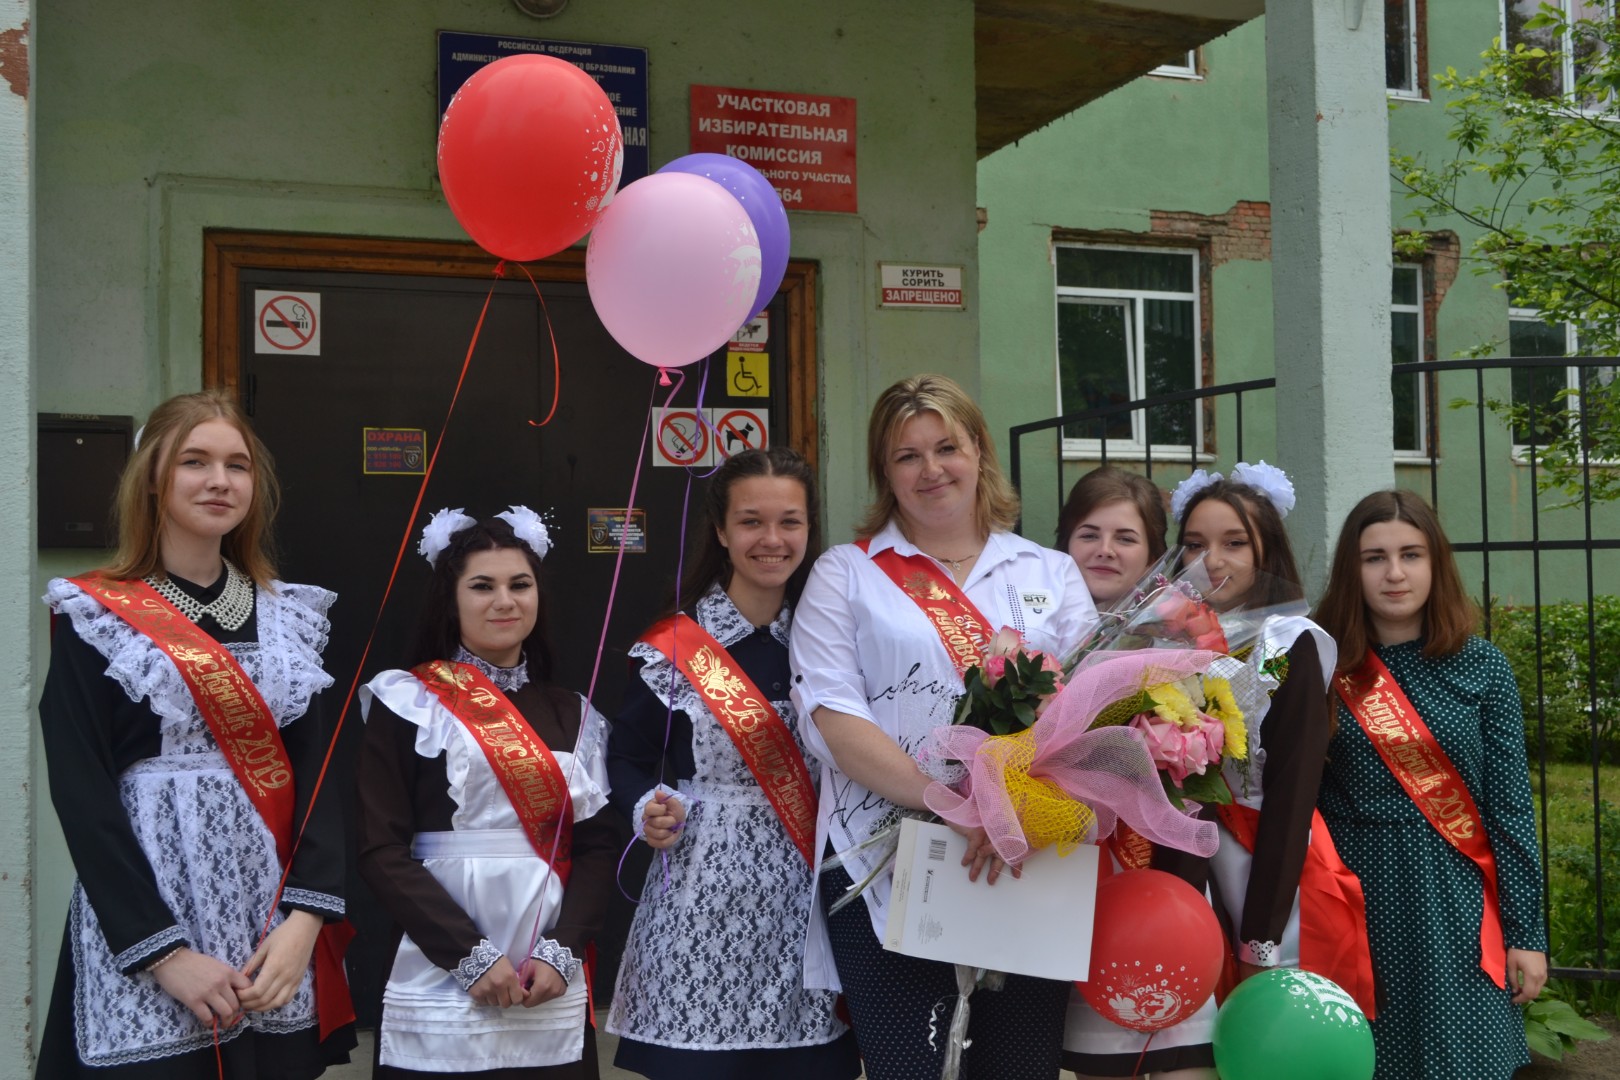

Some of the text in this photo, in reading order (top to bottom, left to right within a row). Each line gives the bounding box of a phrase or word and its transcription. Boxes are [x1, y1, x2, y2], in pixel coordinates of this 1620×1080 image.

[497, 41, 592, 56] РОССИЙСКАЯ ФЕДЕРАЦИЯ
[585, 63, 636, 75] ОБРАЗОВАНИЯ
[717, 94, 831, 118] УЧАСТКОВАЯ
[699, 117, 848, 143] ИЗБИРАТЕЛЬНАЯ
[726, 144, 822, 165] КОМИССИЯ
[802, 171, 852, 185] УЧАСТКА
[901, 268, 944, 279] КУРИТЬ
[901, 278, 945, 288] СОРИТЬ
[885, 288, 960, 303] ЗАПРЕЩЕНО!
[367, 432, 421, 442] ОХРАНА
[235, 730, 291, 789] 2019
[725, 697, 816, 838] Выпускник
[1428, 788, 1478, 839] 2019
[1130, 983, 1158, 999] УРА!
